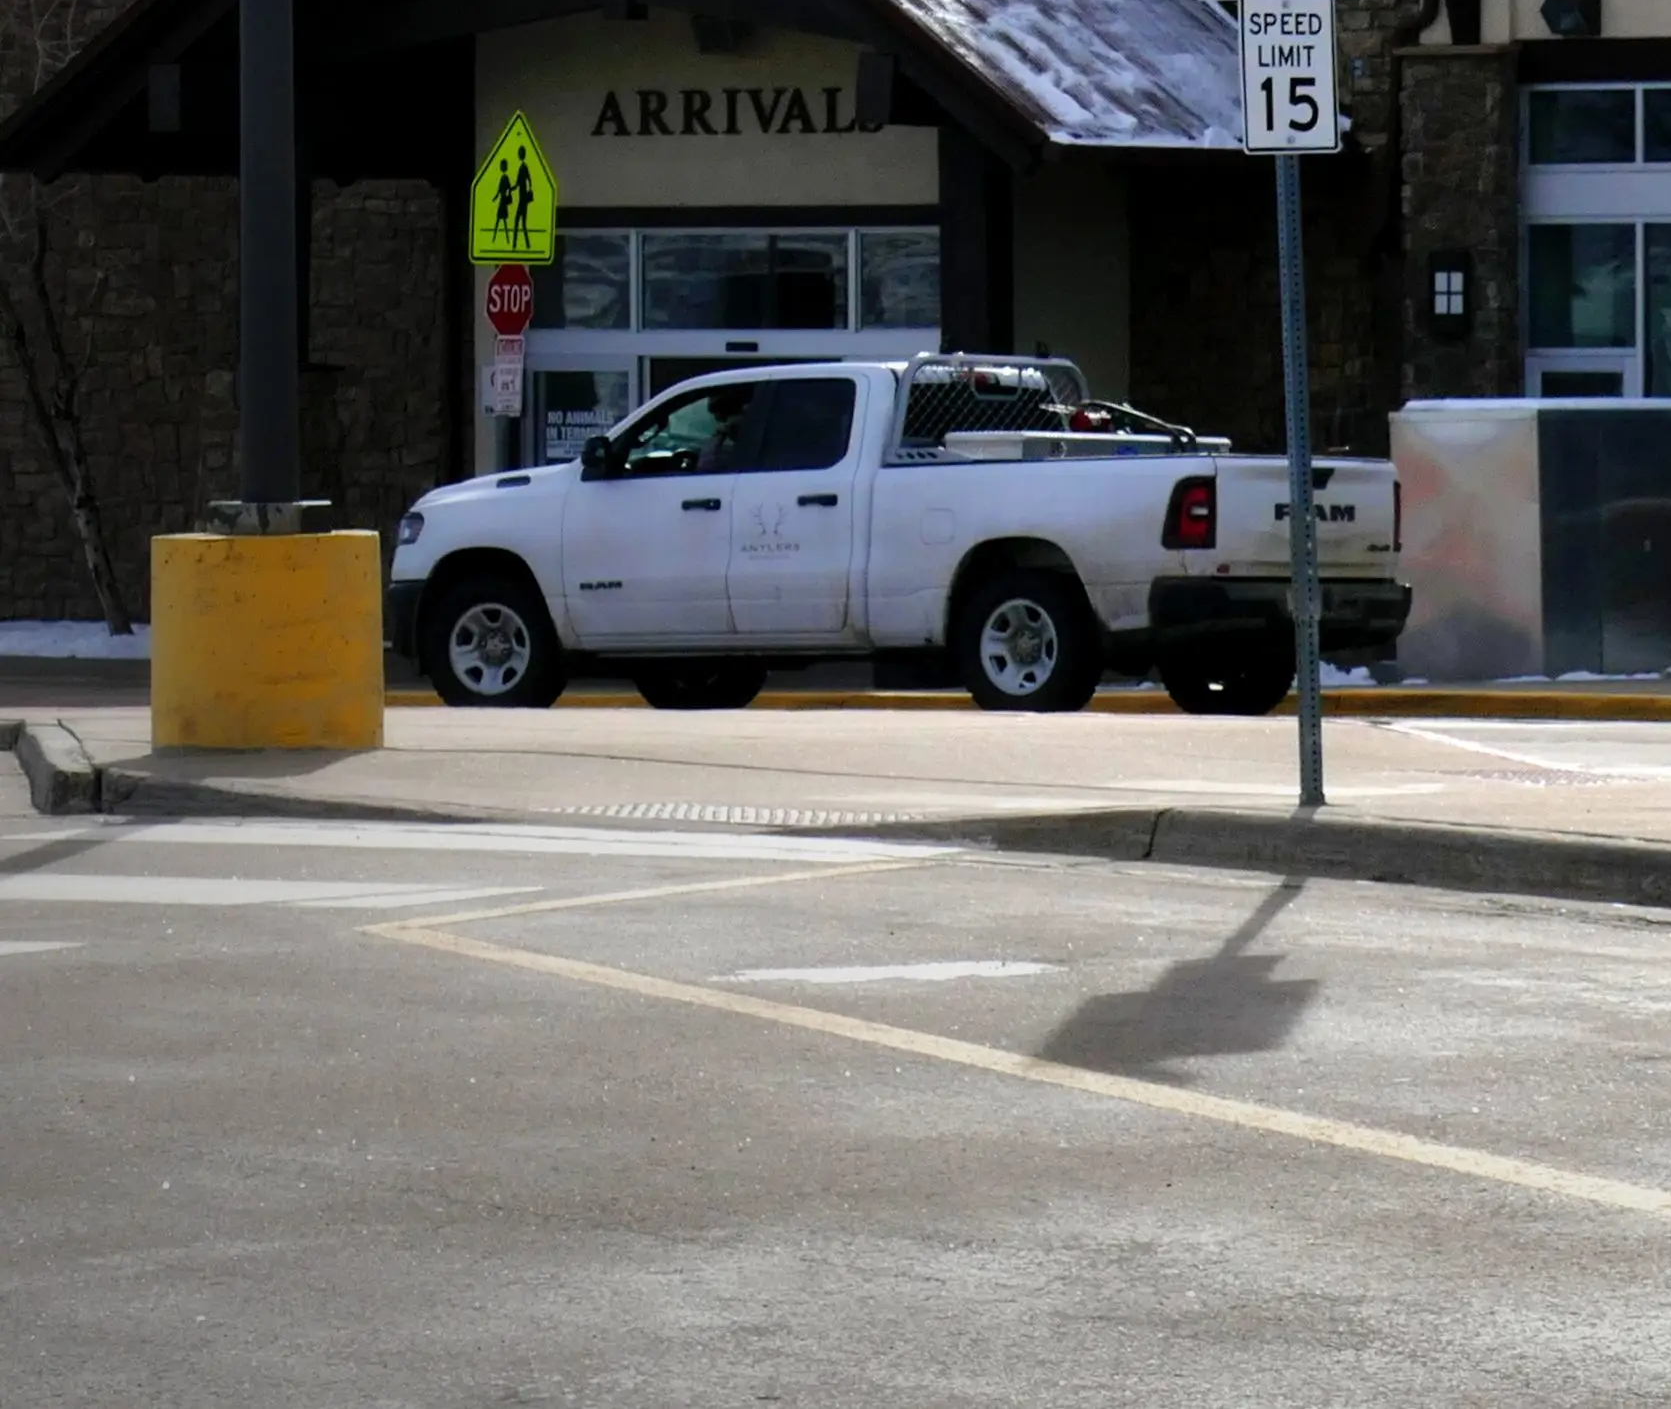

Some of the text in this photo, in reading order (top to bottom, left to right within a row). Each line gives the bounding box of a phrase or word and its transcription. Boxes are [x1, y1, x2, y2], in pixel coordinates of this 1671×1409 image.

[1249, 13, 1322, 36] SPEED
[1258, 45, 1315, 68] LIMIT
[591, 87, 883, 136] ARRIVAL
[1260, 76, 1319, 133] 15
[488, 284, 531, 313] STOP
[547, 410, 563, 424] NO
